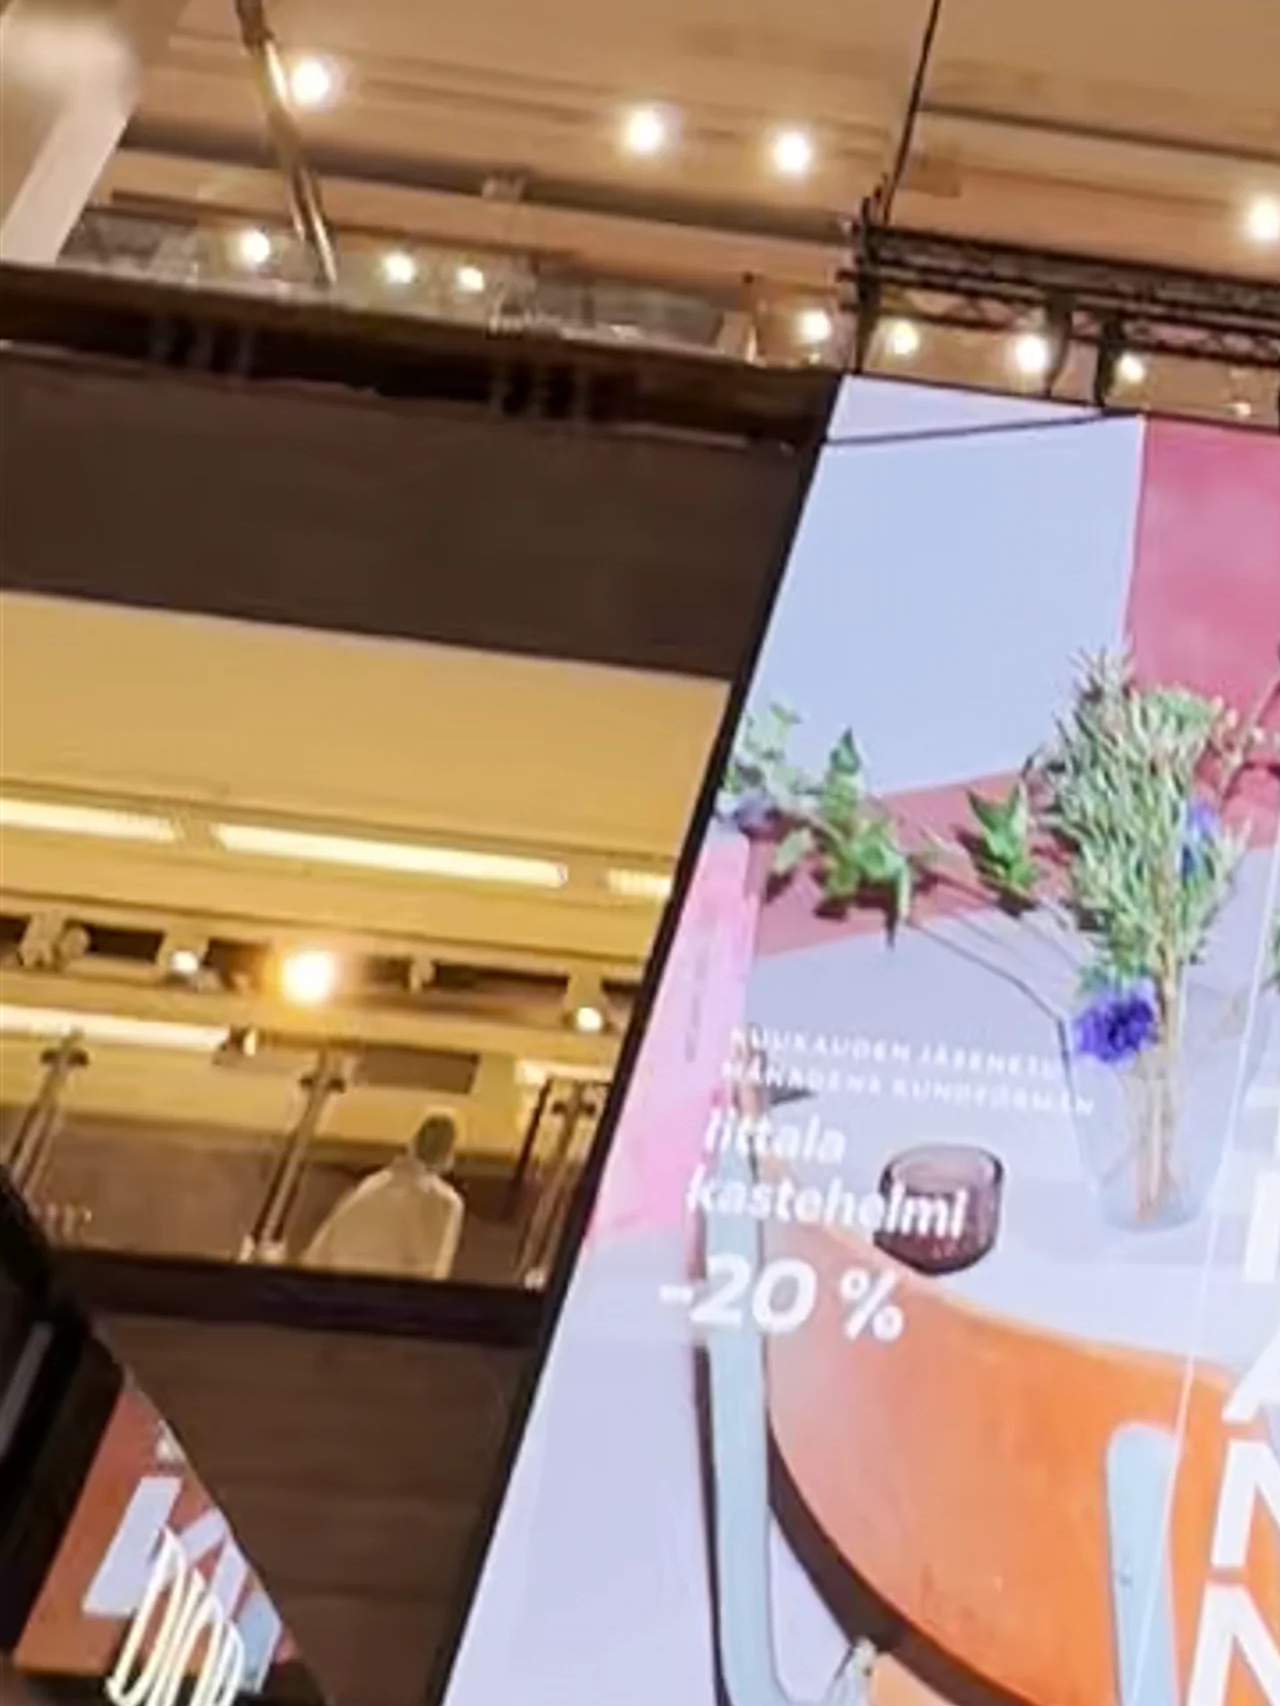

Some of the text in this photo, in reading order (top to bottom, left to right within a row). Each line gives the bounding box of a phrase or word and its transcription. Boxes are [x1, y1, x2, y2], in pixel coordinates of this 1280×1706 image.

[685, 1162, 967, 1238] kastehelmi
[659, 1253, 905, 1343] -20 %
